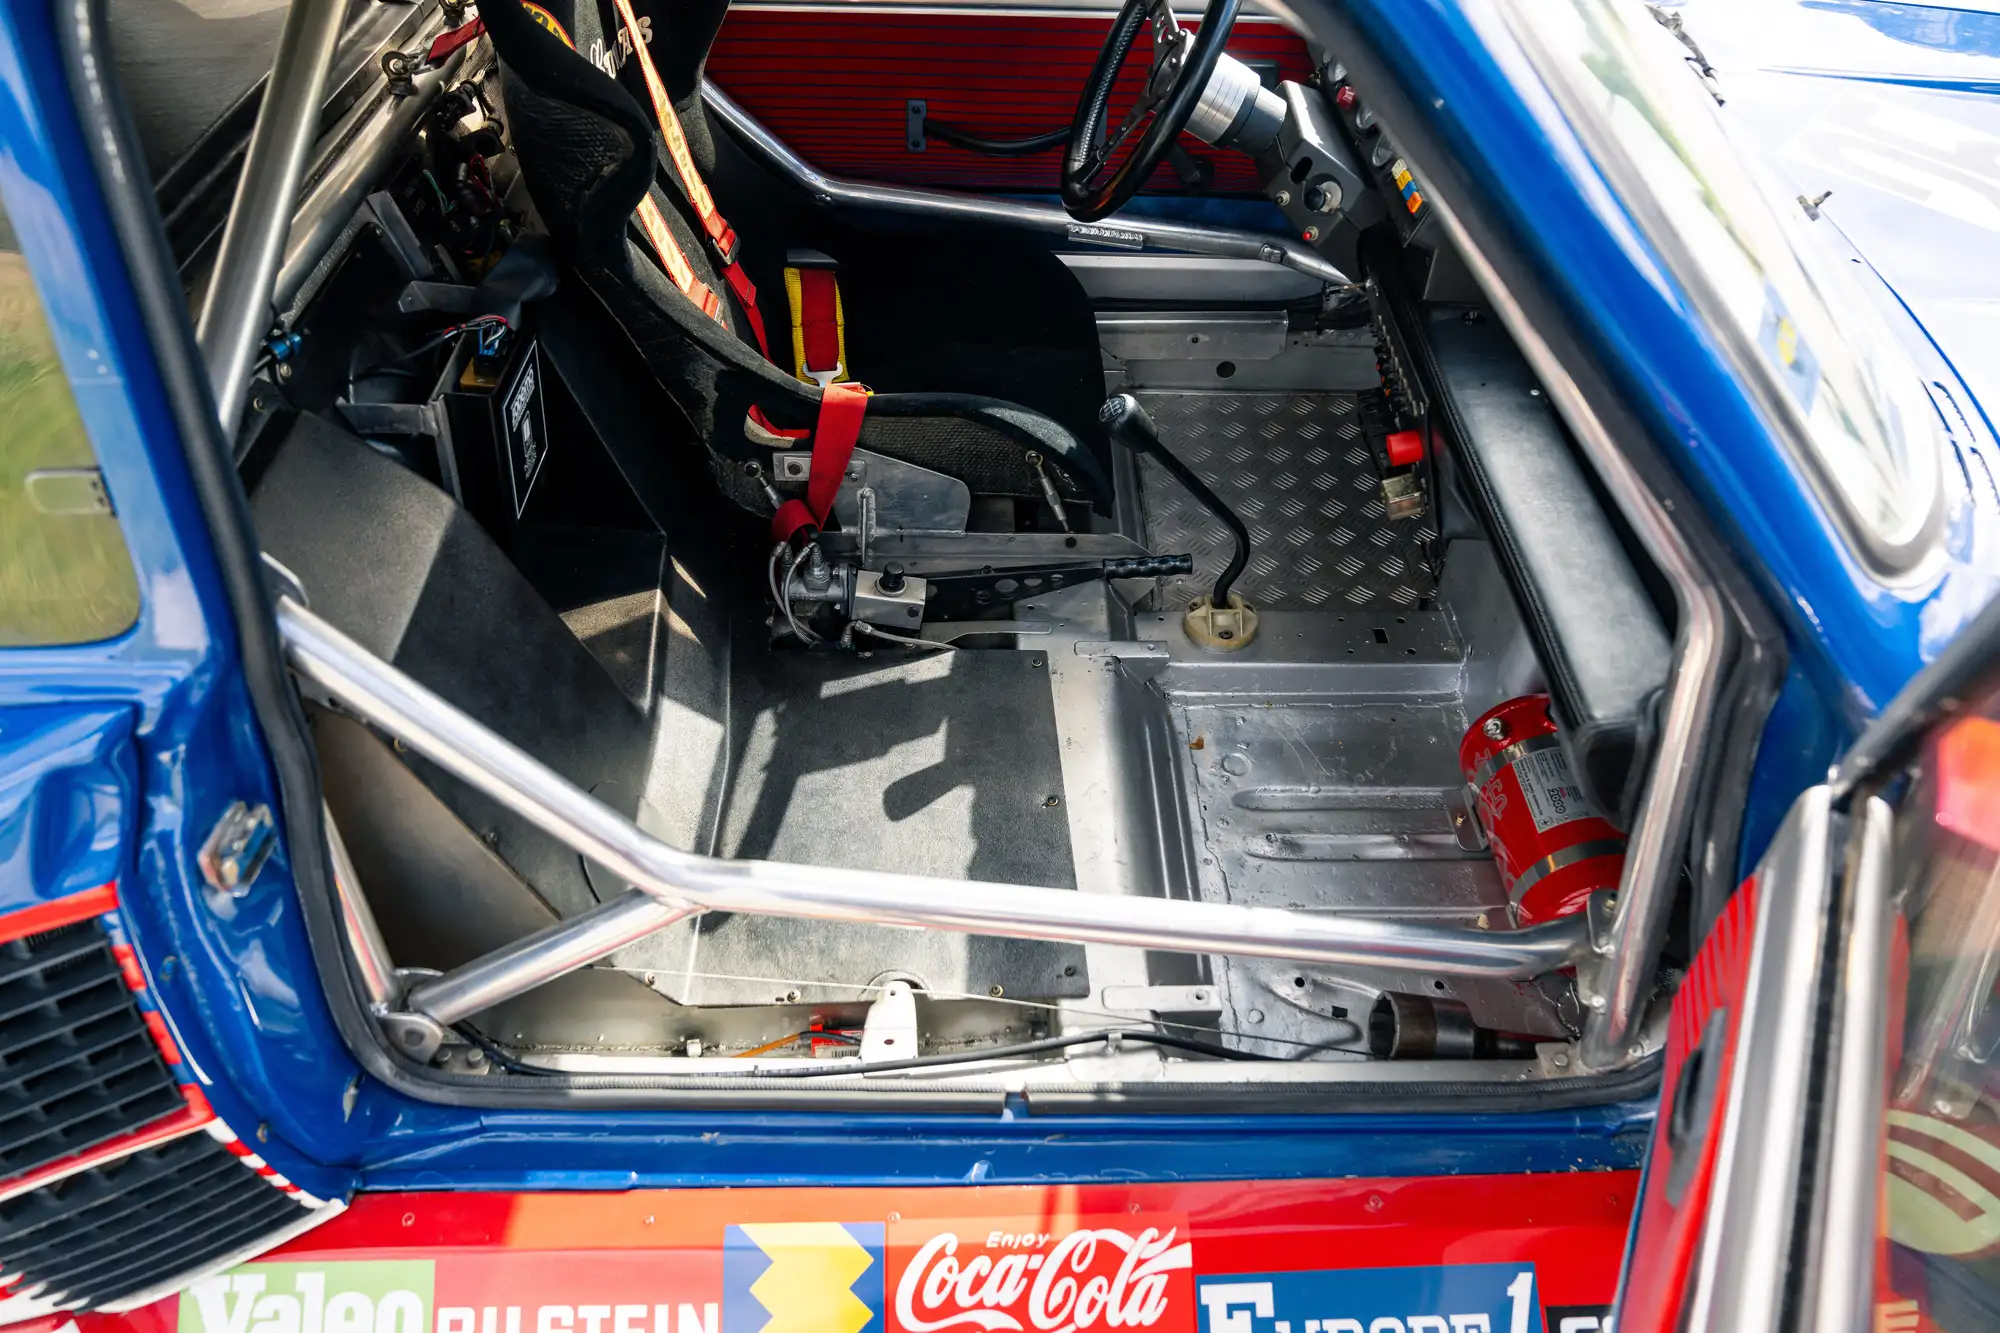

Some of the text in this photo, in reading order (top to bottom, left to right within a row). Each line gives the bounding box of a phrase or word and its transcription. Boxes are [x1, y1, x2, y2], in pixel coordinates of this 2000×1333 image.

[1547, 788, 1566, 814] 2000
[986, 1231, 1050, 1249] Enjoy
[895, 1226, 1193, 1333] Coca-Cola
[190, 1272, 424, 1333] Valeo
